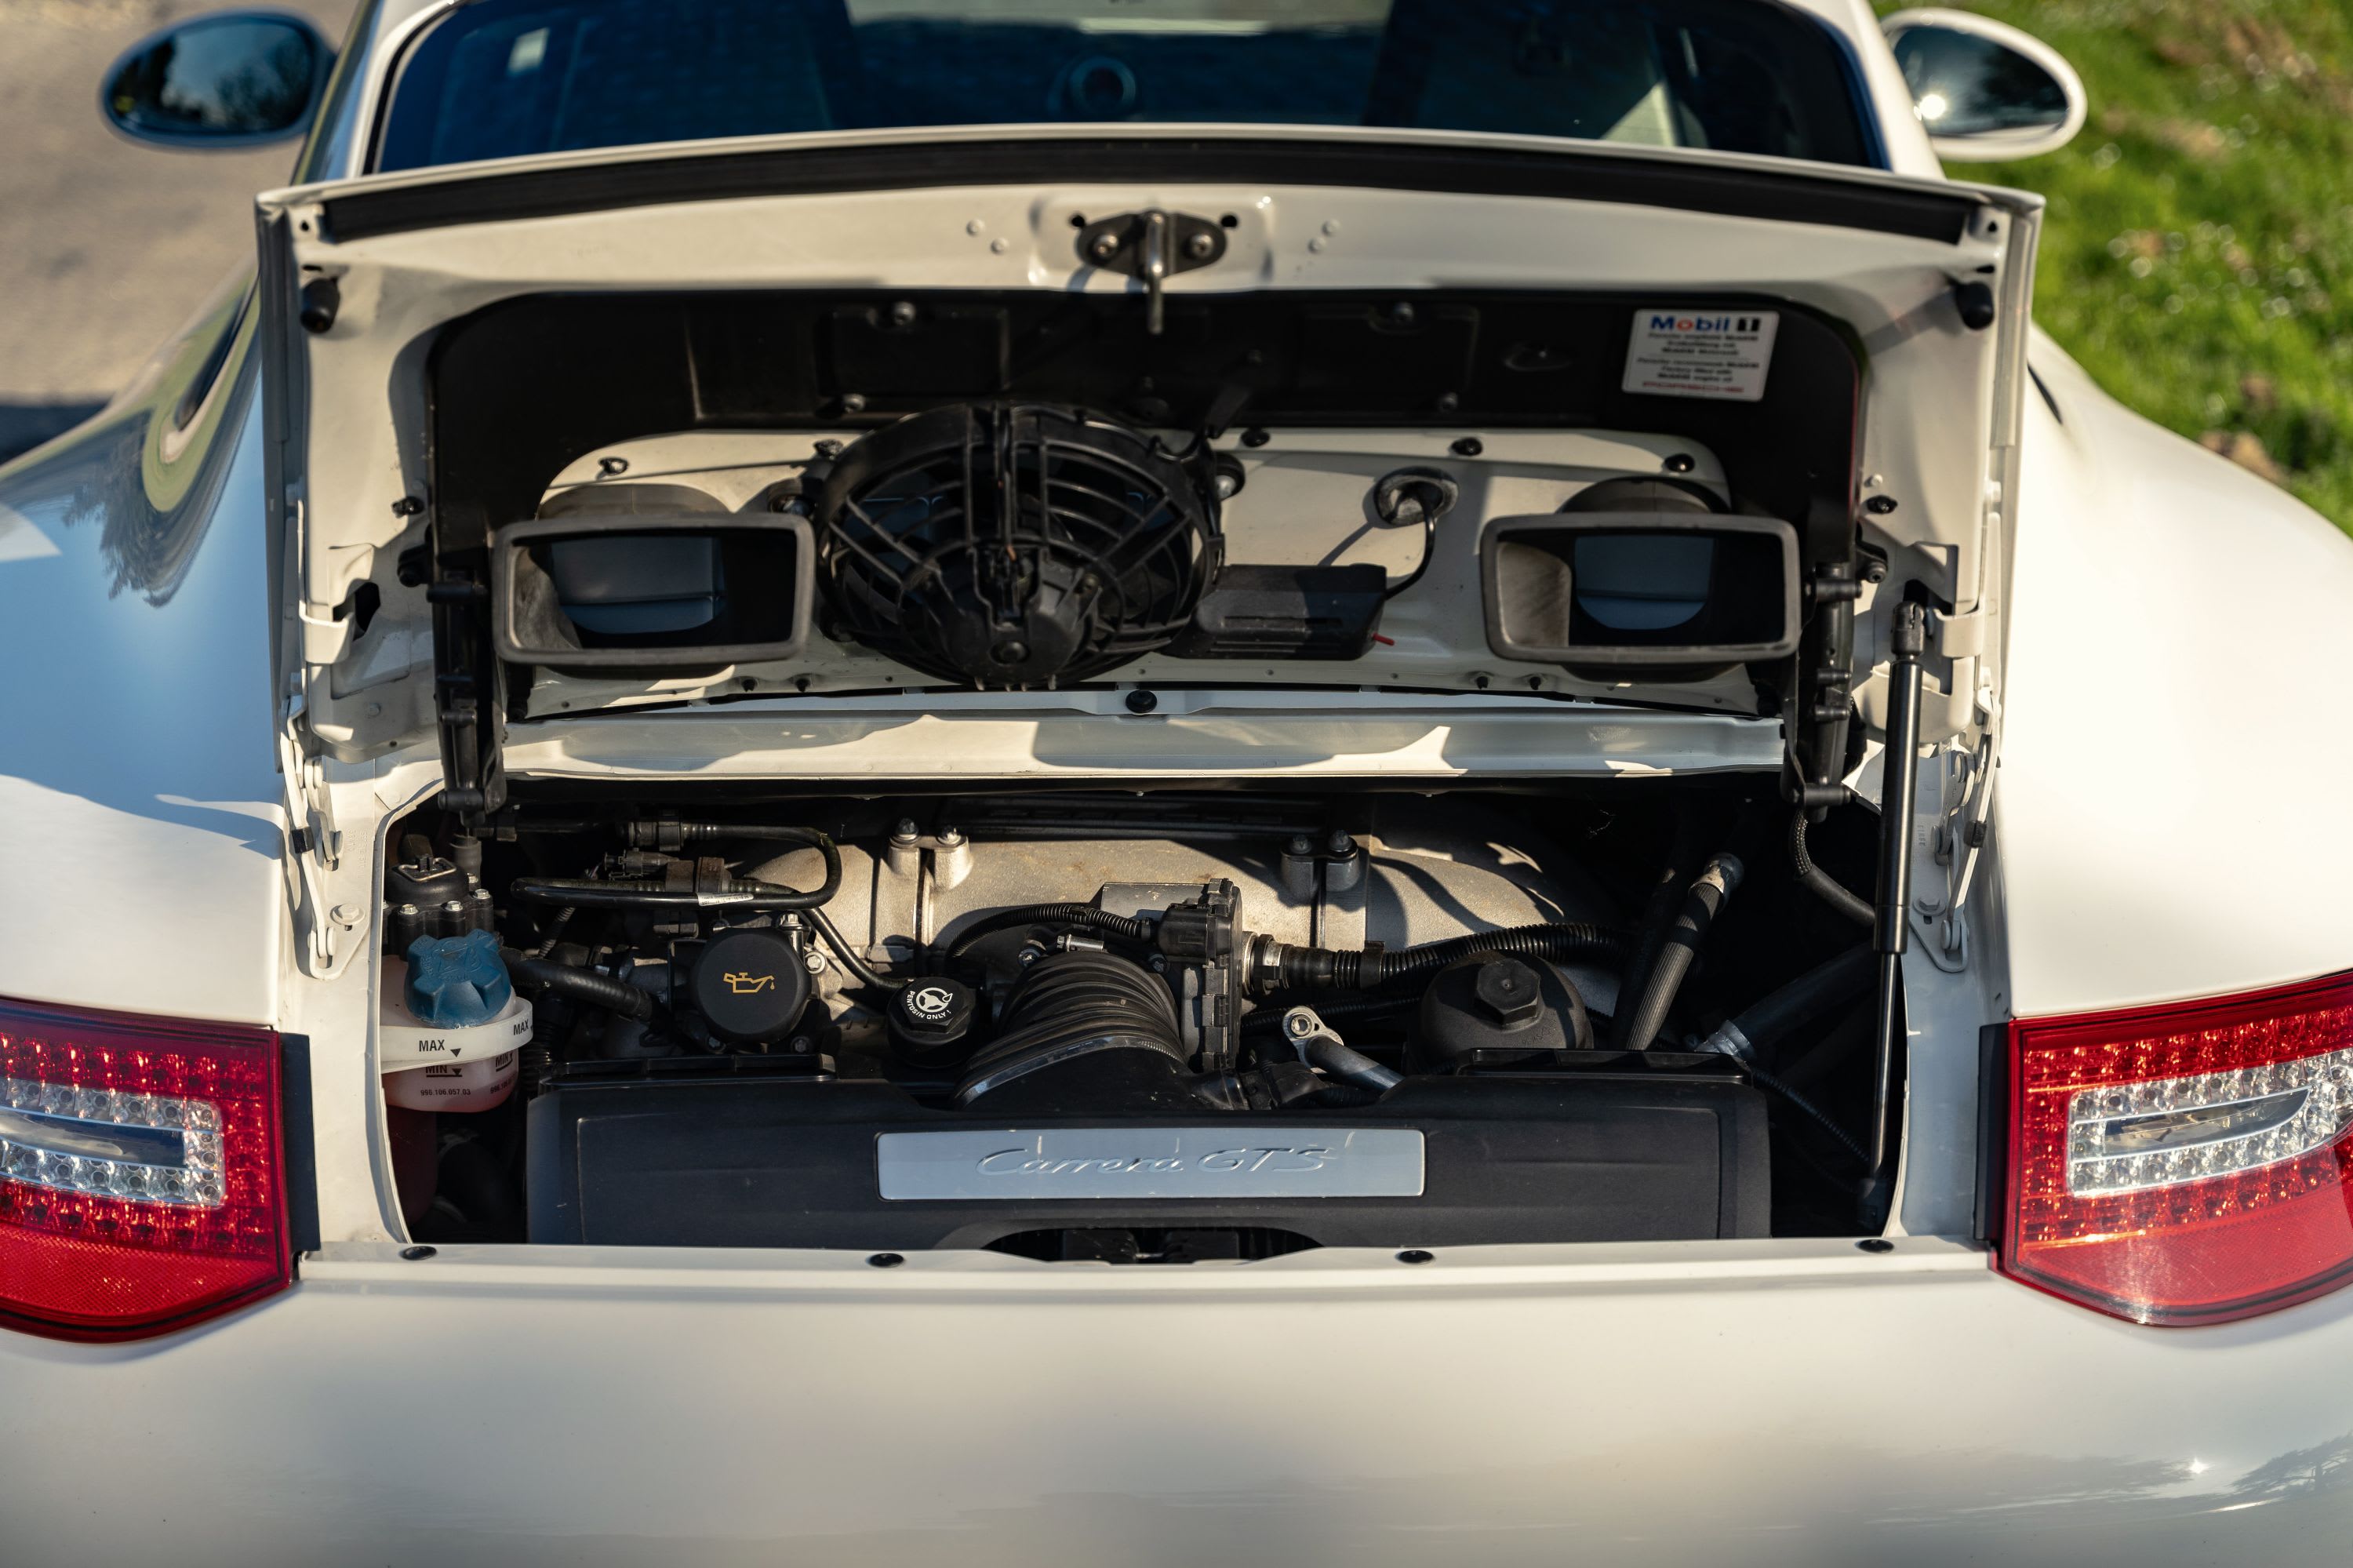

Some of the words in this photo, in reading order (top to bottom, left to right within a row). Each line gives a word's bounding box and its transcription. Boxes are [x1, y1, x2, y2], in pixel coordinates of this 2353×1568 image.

[1650, 315, 1731, 331] Mobil
[907, 991, 926, 1018] PENTOSIN
[513, 1020, 529, 1035] MAX
[419, 1039, 446, 1052] MAX
[496, 1053, 509, 1068] MIN
[426, 1065, 448, 1074] MIN
[976, 1148, 1184, 1176] Carrera
[1198, 1147, 1331, 1173] GTS
